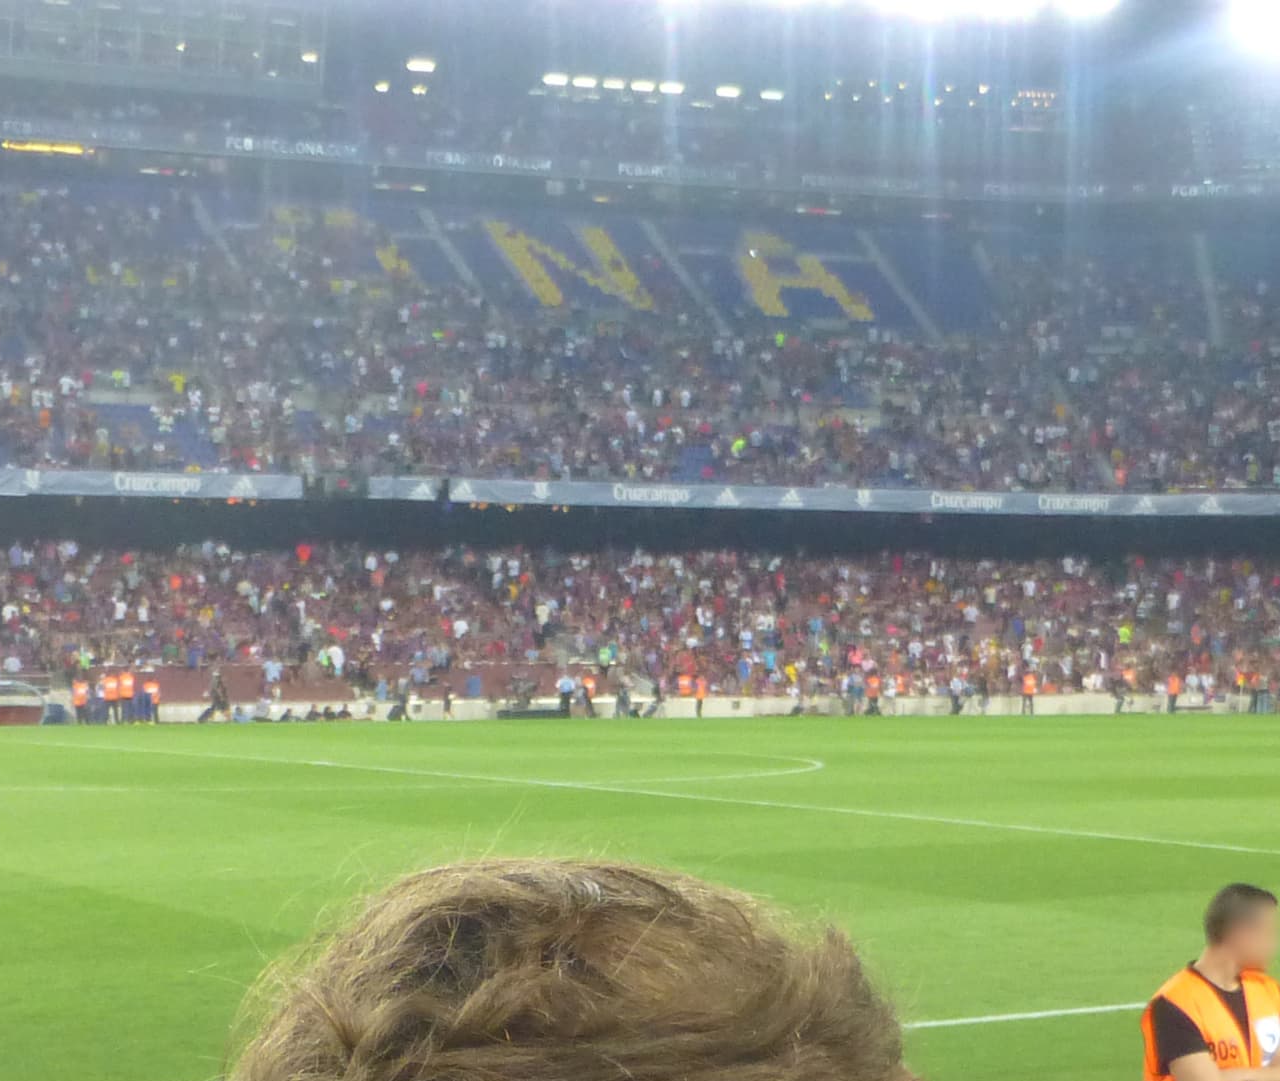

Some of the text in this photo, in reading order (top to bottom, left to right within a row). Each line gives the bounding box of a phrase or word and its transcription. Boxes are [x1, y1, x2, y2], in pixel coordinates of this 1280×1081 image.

[114, 472, 202, 493] Cruzcampo
[613, 484, 690, 504] Cruzcampo
[931, 493, 1003, 511] Cruzcampo
[1038, 493, 1110, 511] Cruzcampo
